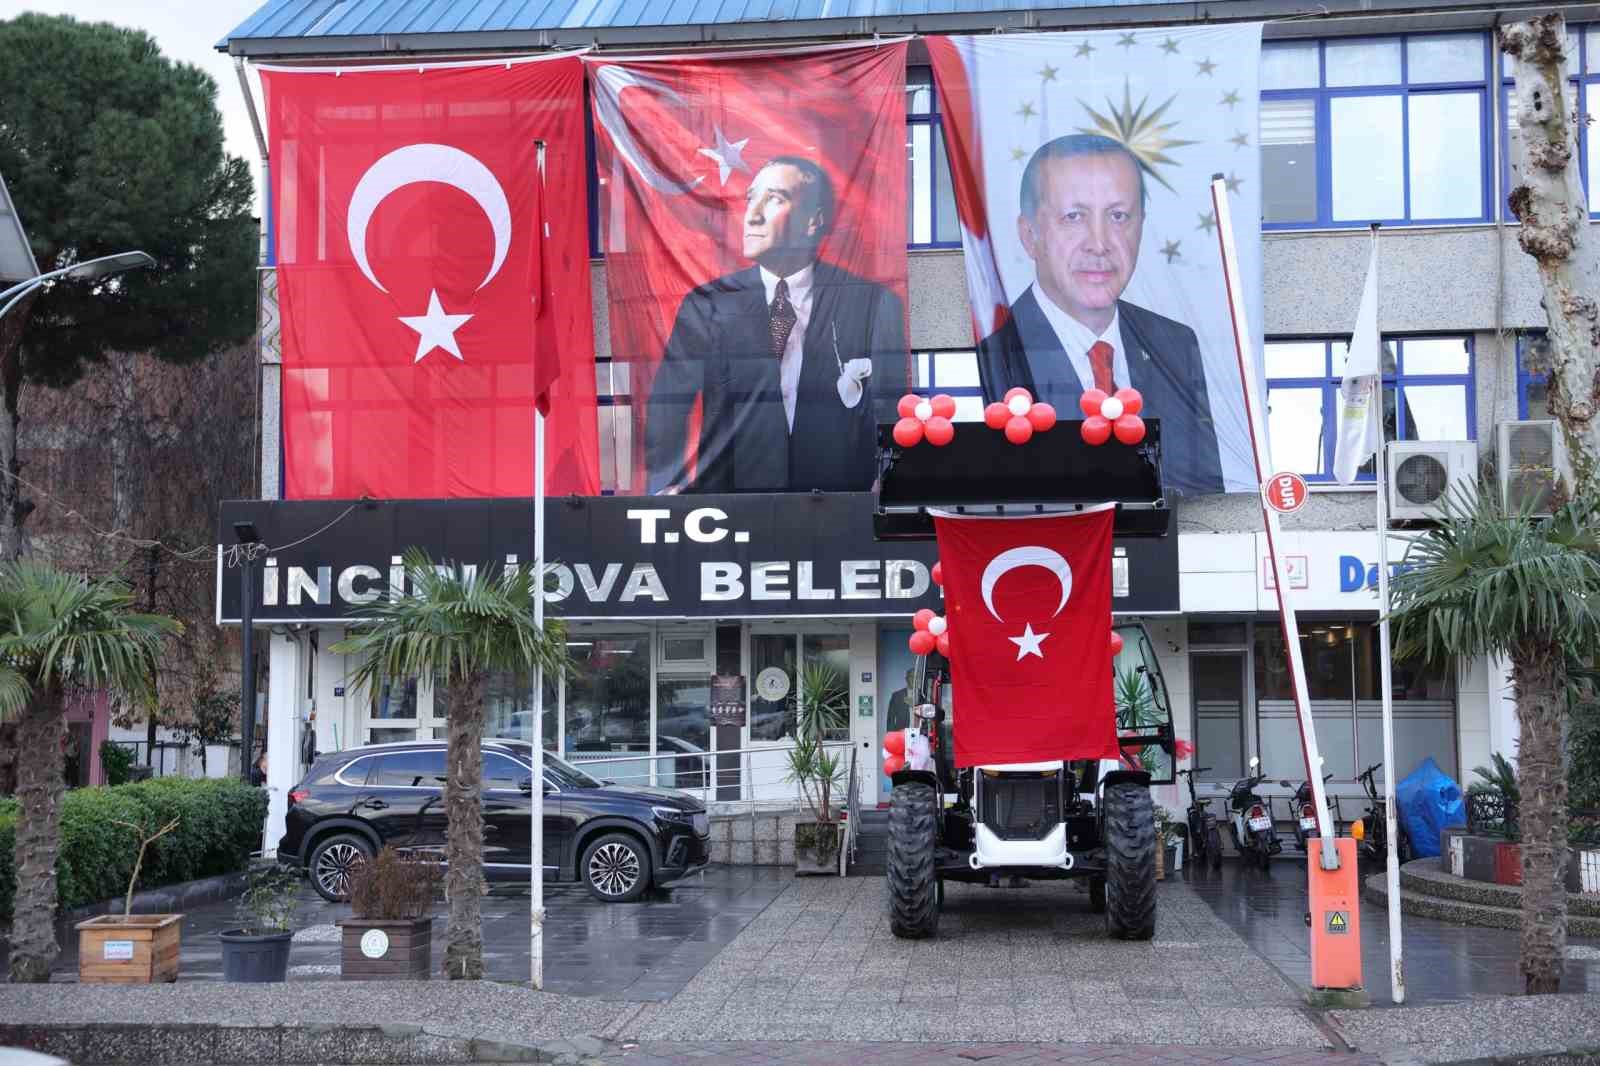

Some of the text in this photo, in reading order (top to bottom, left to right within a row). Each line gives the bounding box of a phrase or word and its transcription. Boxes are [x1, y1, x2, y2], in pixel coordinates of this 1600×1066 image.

[1279, 477, 1296, 507] DUR
[627, 508, 750, 544] T.C.
[700, 547, 1129, 601] BELEDİ
